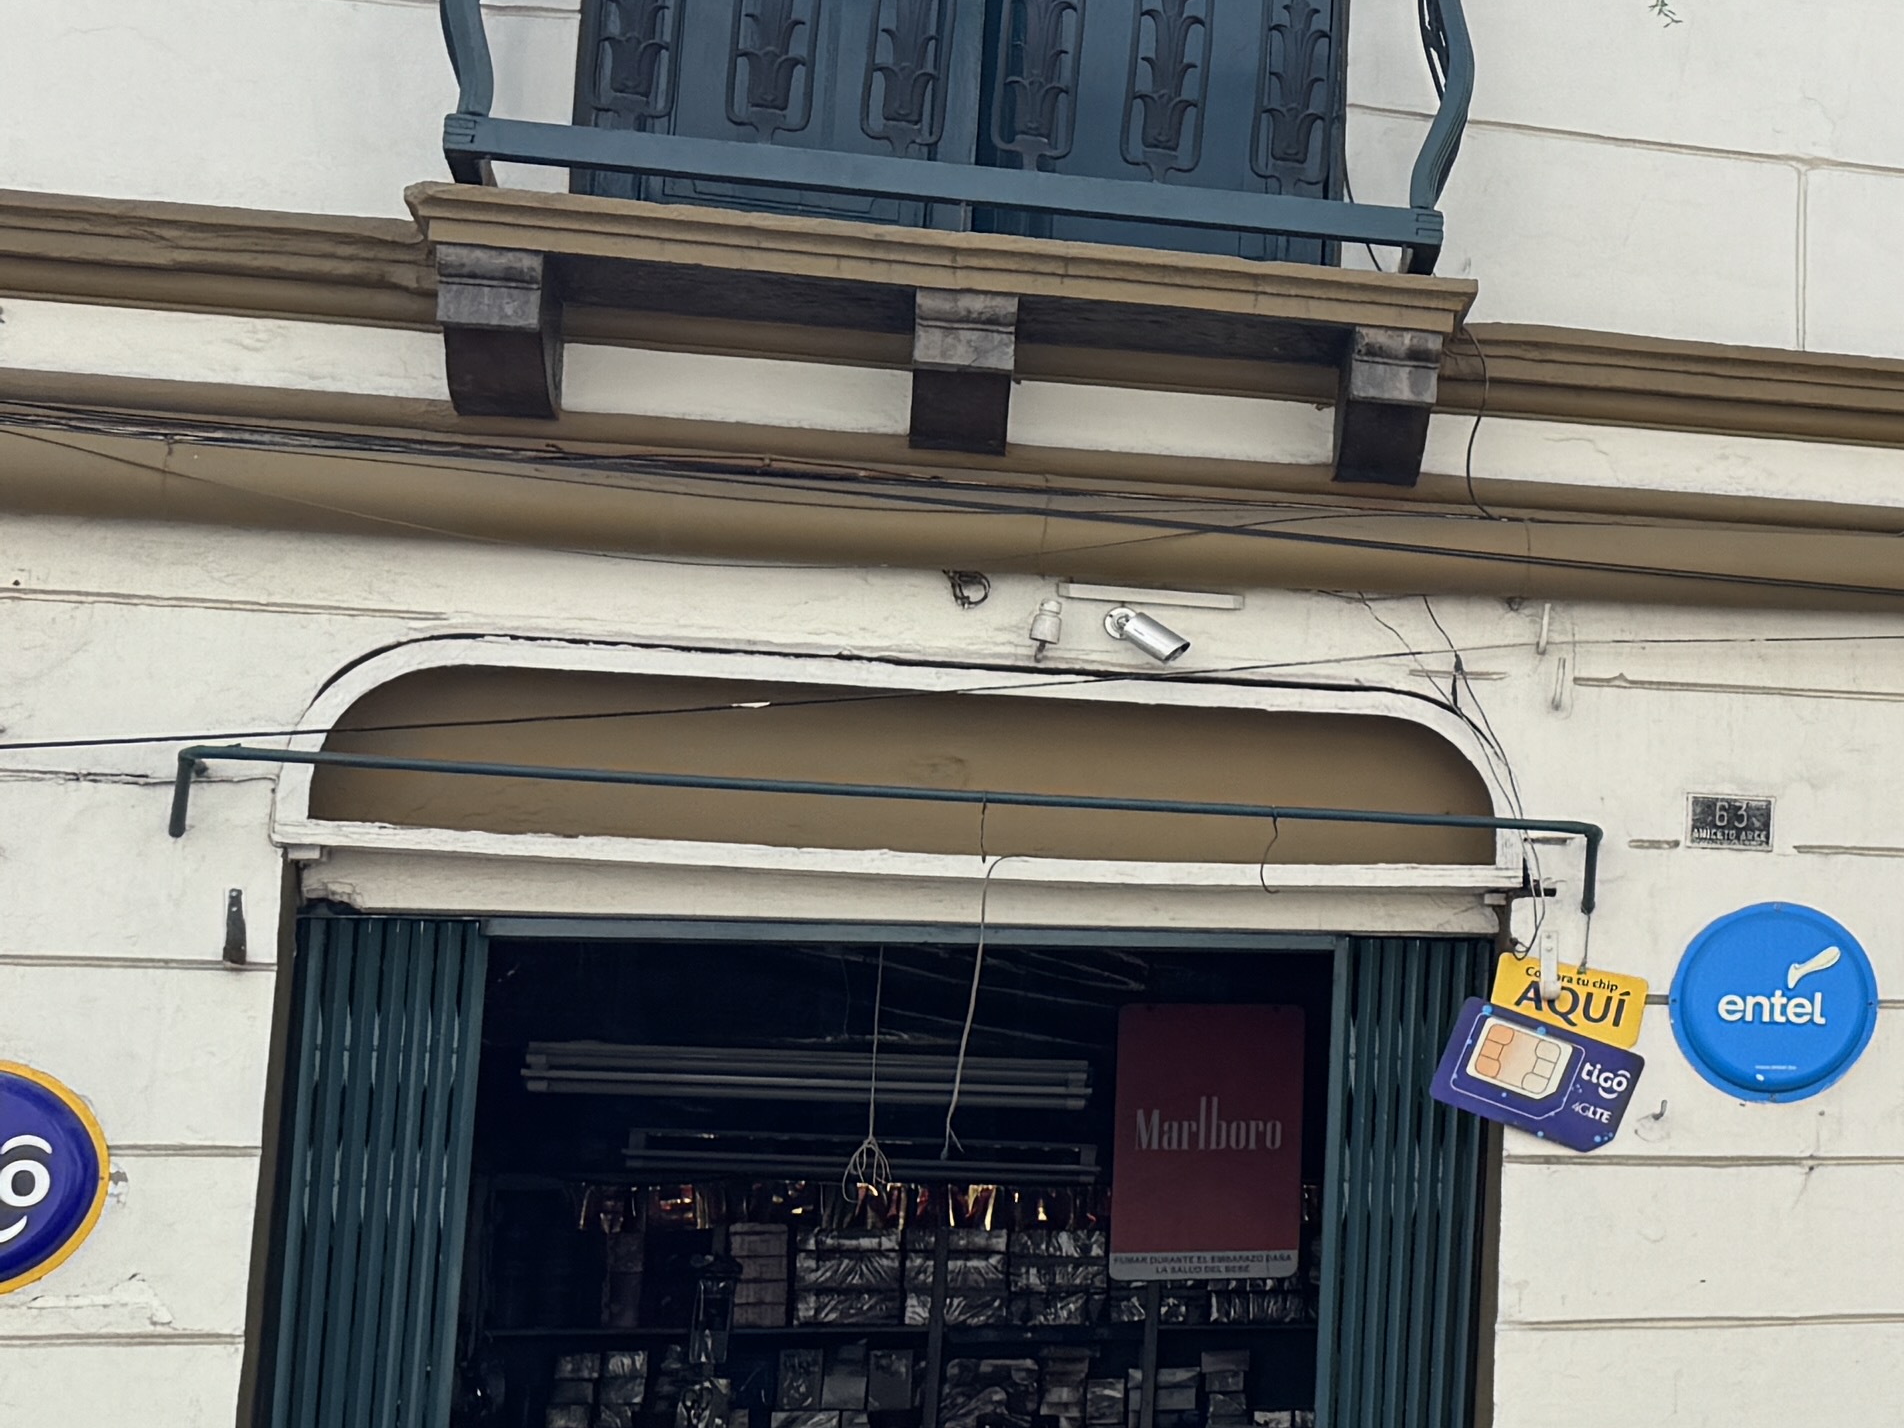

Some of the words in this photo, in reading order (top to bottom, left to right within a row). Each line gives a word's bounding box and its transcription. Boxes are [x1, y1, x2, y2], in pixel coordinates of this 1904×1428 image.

[1715, 801, 1748, 828] 63
[1526, 967, 1573, 986] Cora
[1576, 976, 1590, 988] tu
[1592, 977, 1620, 994] chip
[1514, 980, 1631, 1028] AQUÍ
[1717, 989, 1826, 1026] entel
[1135, 1095, 1282, 1152] Marlboro
